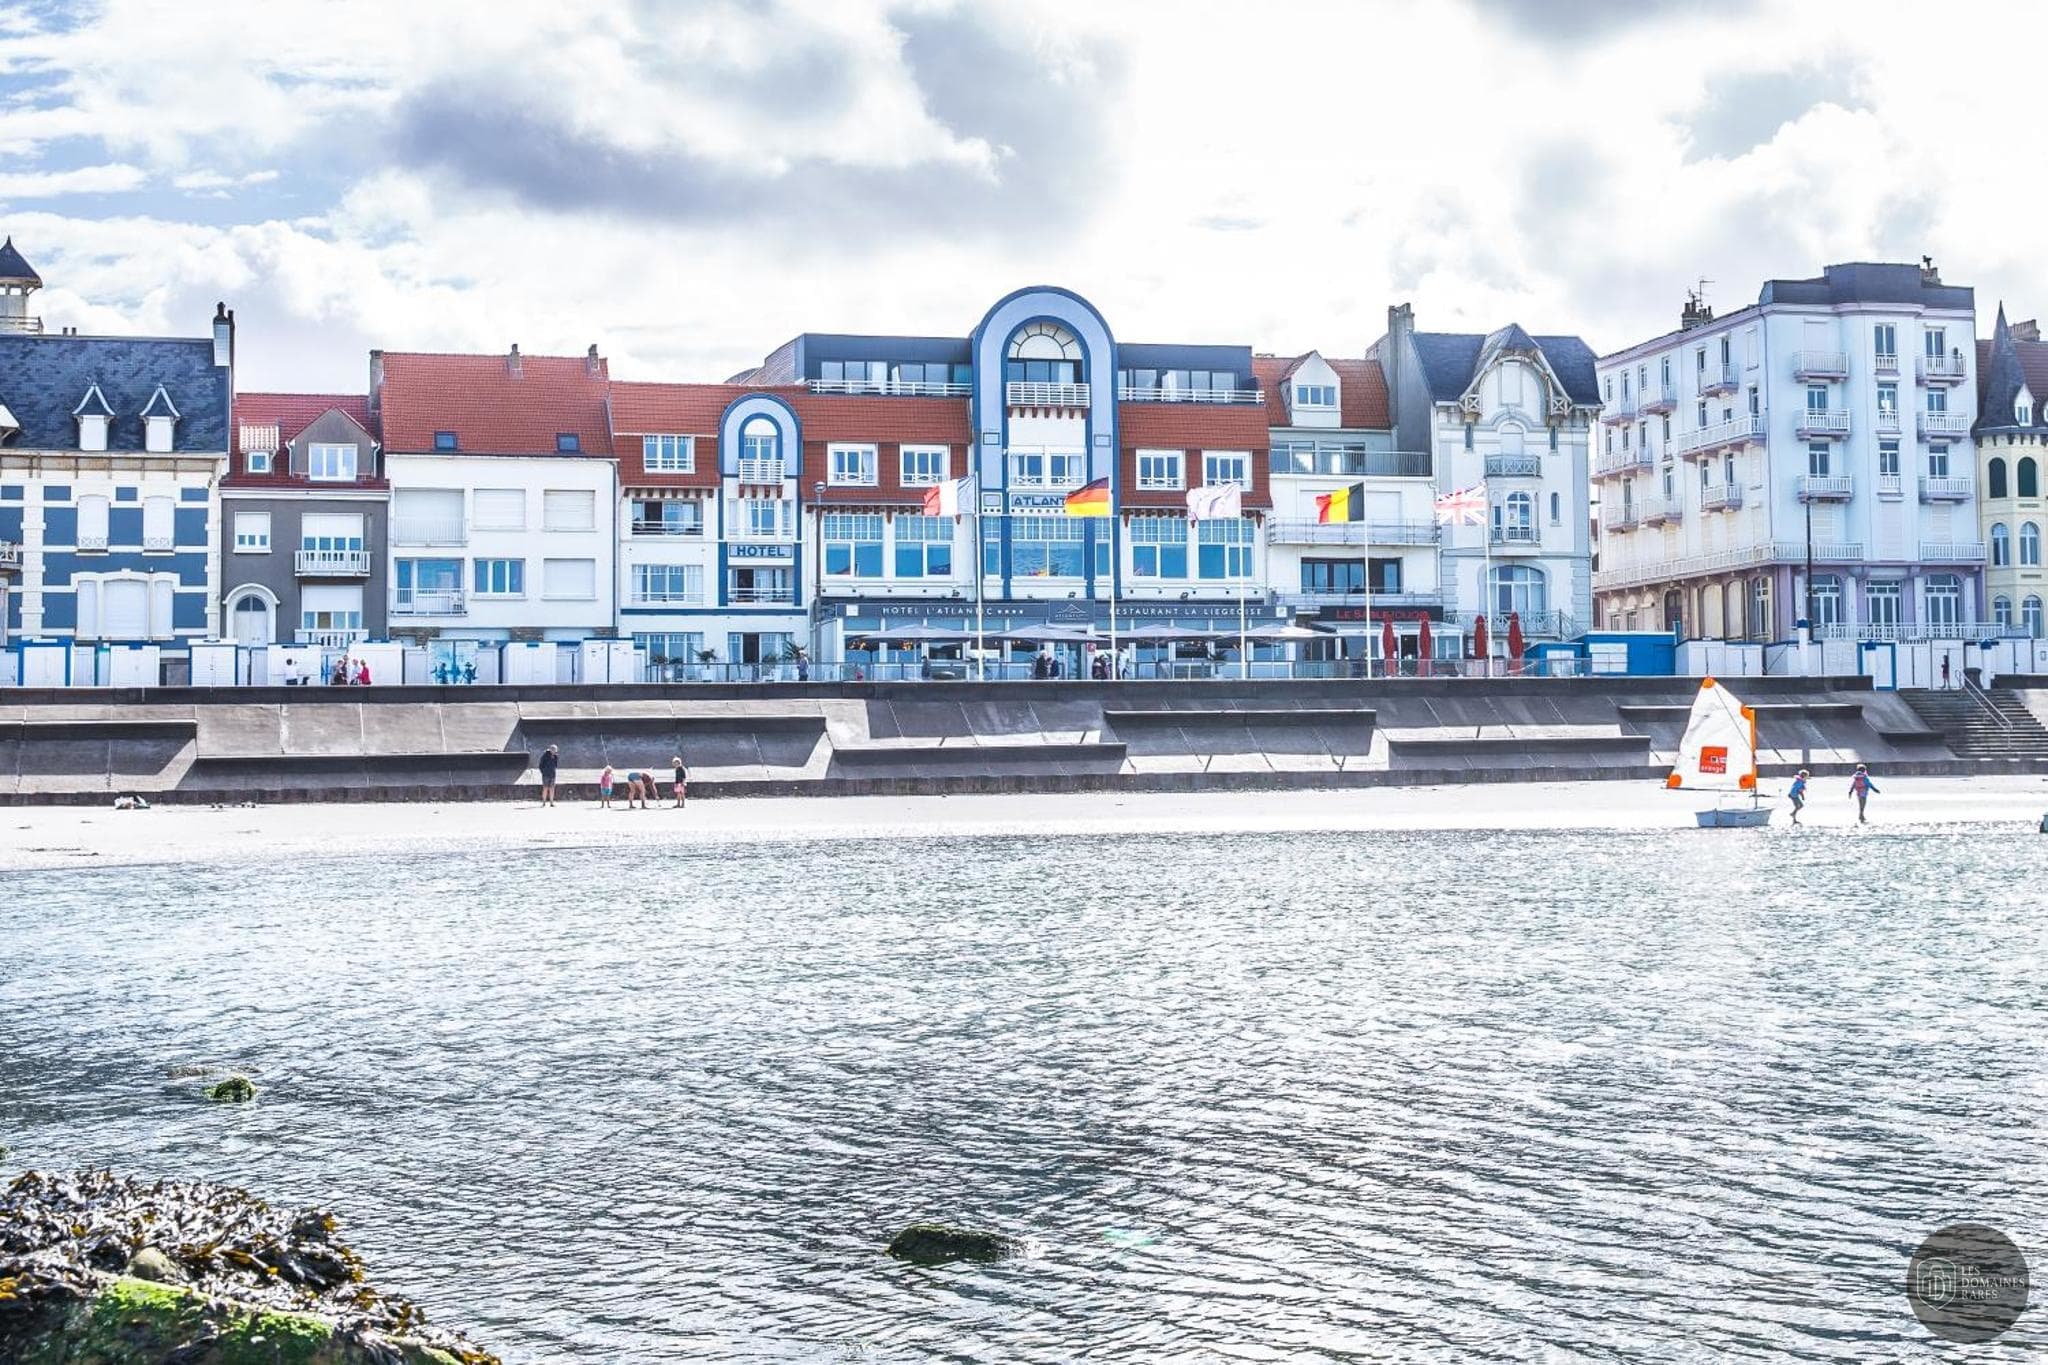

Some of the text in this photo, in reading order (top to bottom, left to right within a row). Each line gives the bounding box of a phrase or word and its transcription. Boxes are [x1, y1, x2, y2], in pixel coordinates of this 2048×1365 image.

[736, 546, 785, 557] HOTEL
[882, 607, 919, 615] HOTEL
[1110, 608, 1178, 616] ESTAURANT
[1184, 608, 1197, 616] LA
